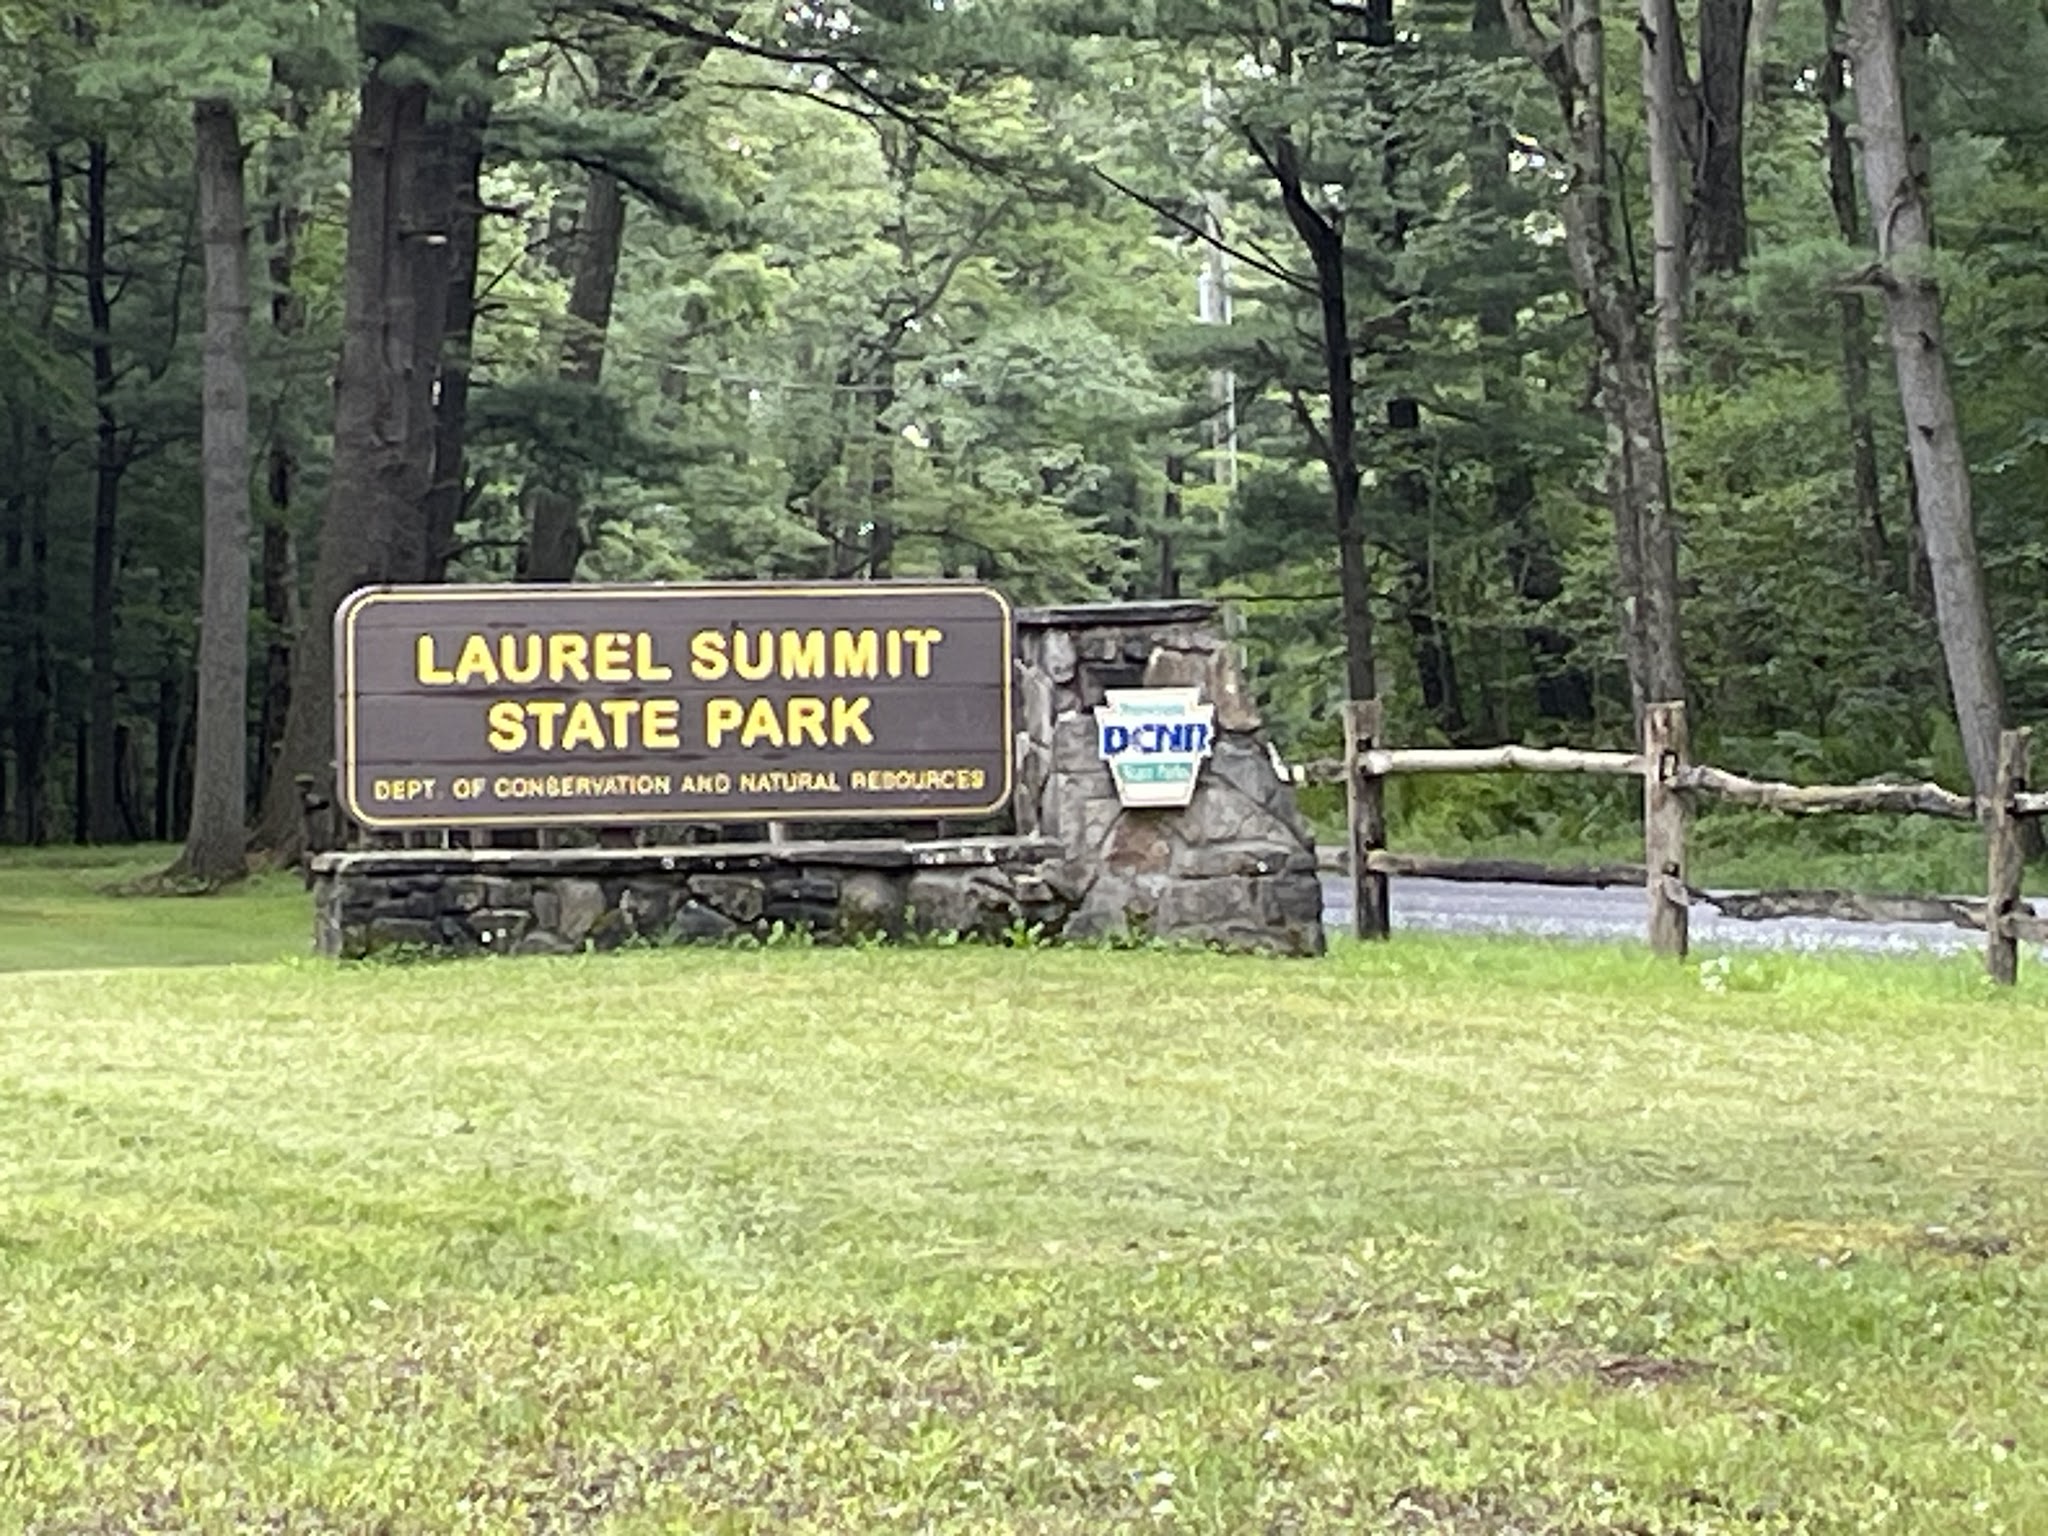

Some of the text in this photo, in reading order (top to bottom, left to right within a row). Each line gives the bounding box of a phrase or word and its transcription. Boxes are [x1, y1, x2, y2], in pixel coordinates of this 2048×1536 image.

[417, 628, 943, 685] LAUREL SUMMIT
[488, 696, 874, 752] STATE PARK
[452, 777, 487, 800] OF
[494, 774, 671, 798] CONSERVATION
[681, 772, 730, 794] AND
[738, 771, 842, 793] NATURAL
[851, 768, 986, 791] RESOURCES
